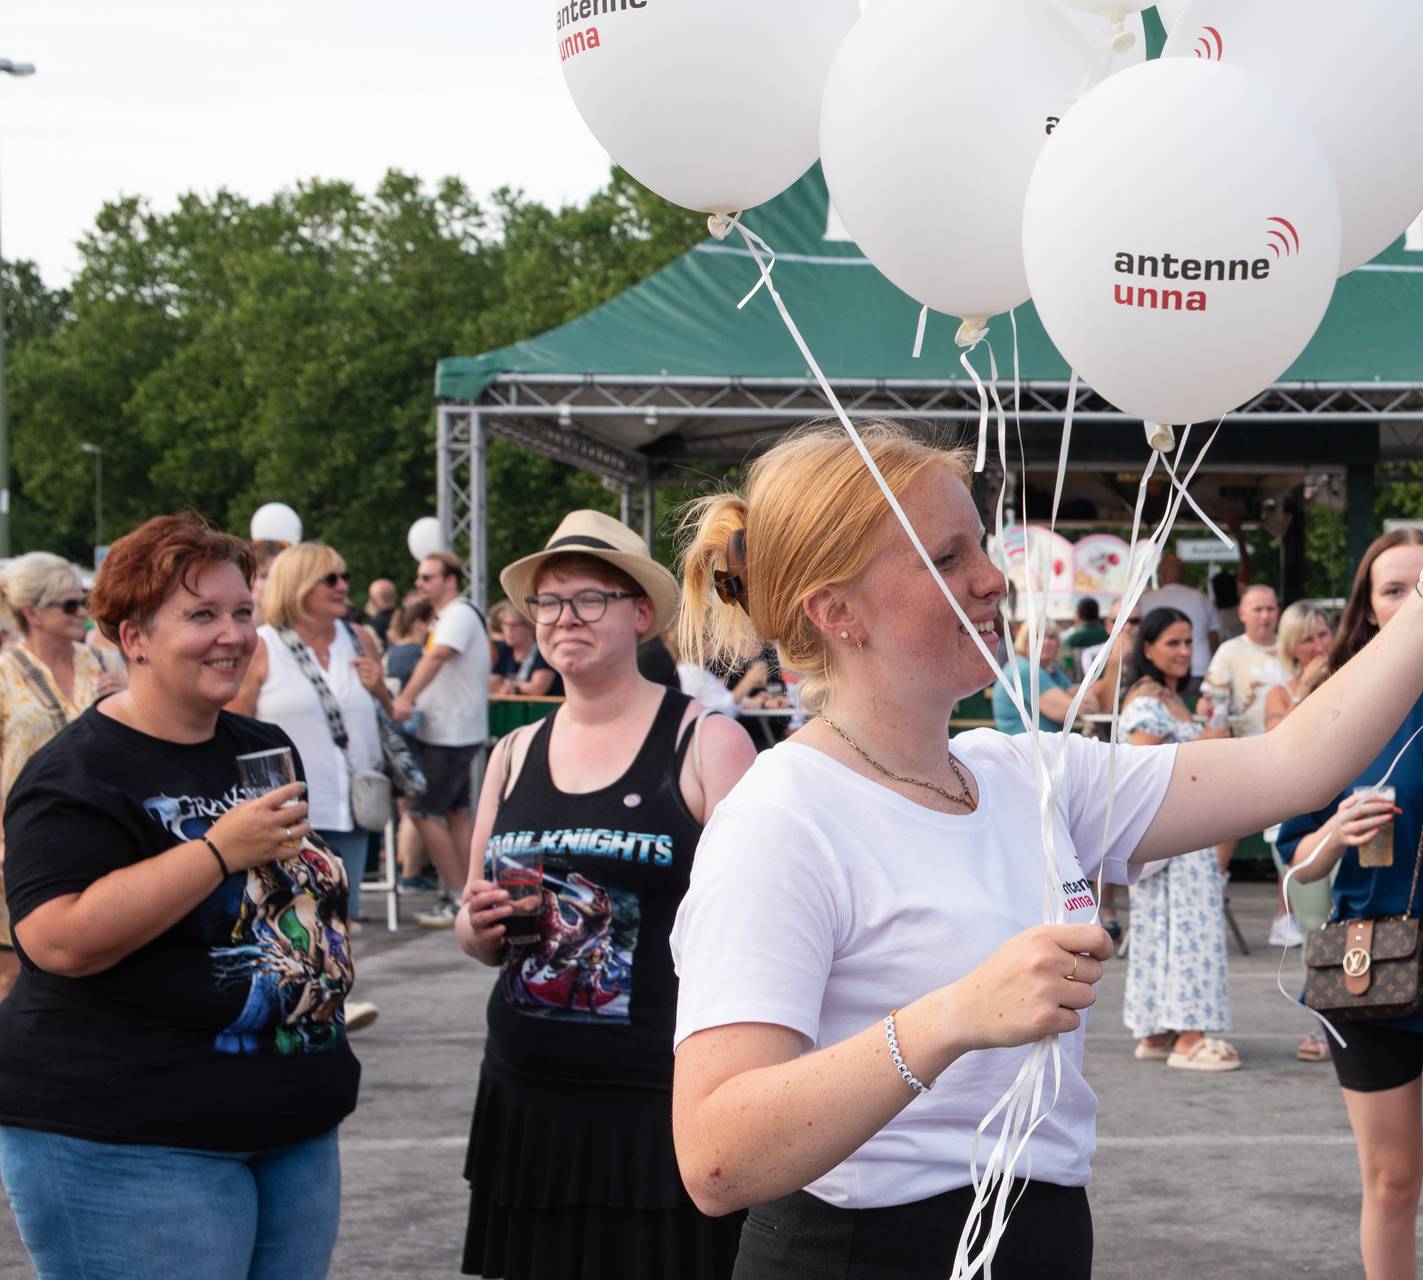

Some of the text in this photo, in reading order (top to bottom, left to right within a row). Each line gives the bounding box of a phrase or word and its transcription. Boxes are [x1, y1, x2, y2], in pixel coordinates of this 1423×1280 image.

[559, 27, 600, 62] unna
[1114, 251, 1270, 281] antenne
[1114, 284, 1207, 311] unna
[1065, 895, 1094, 911] unna
